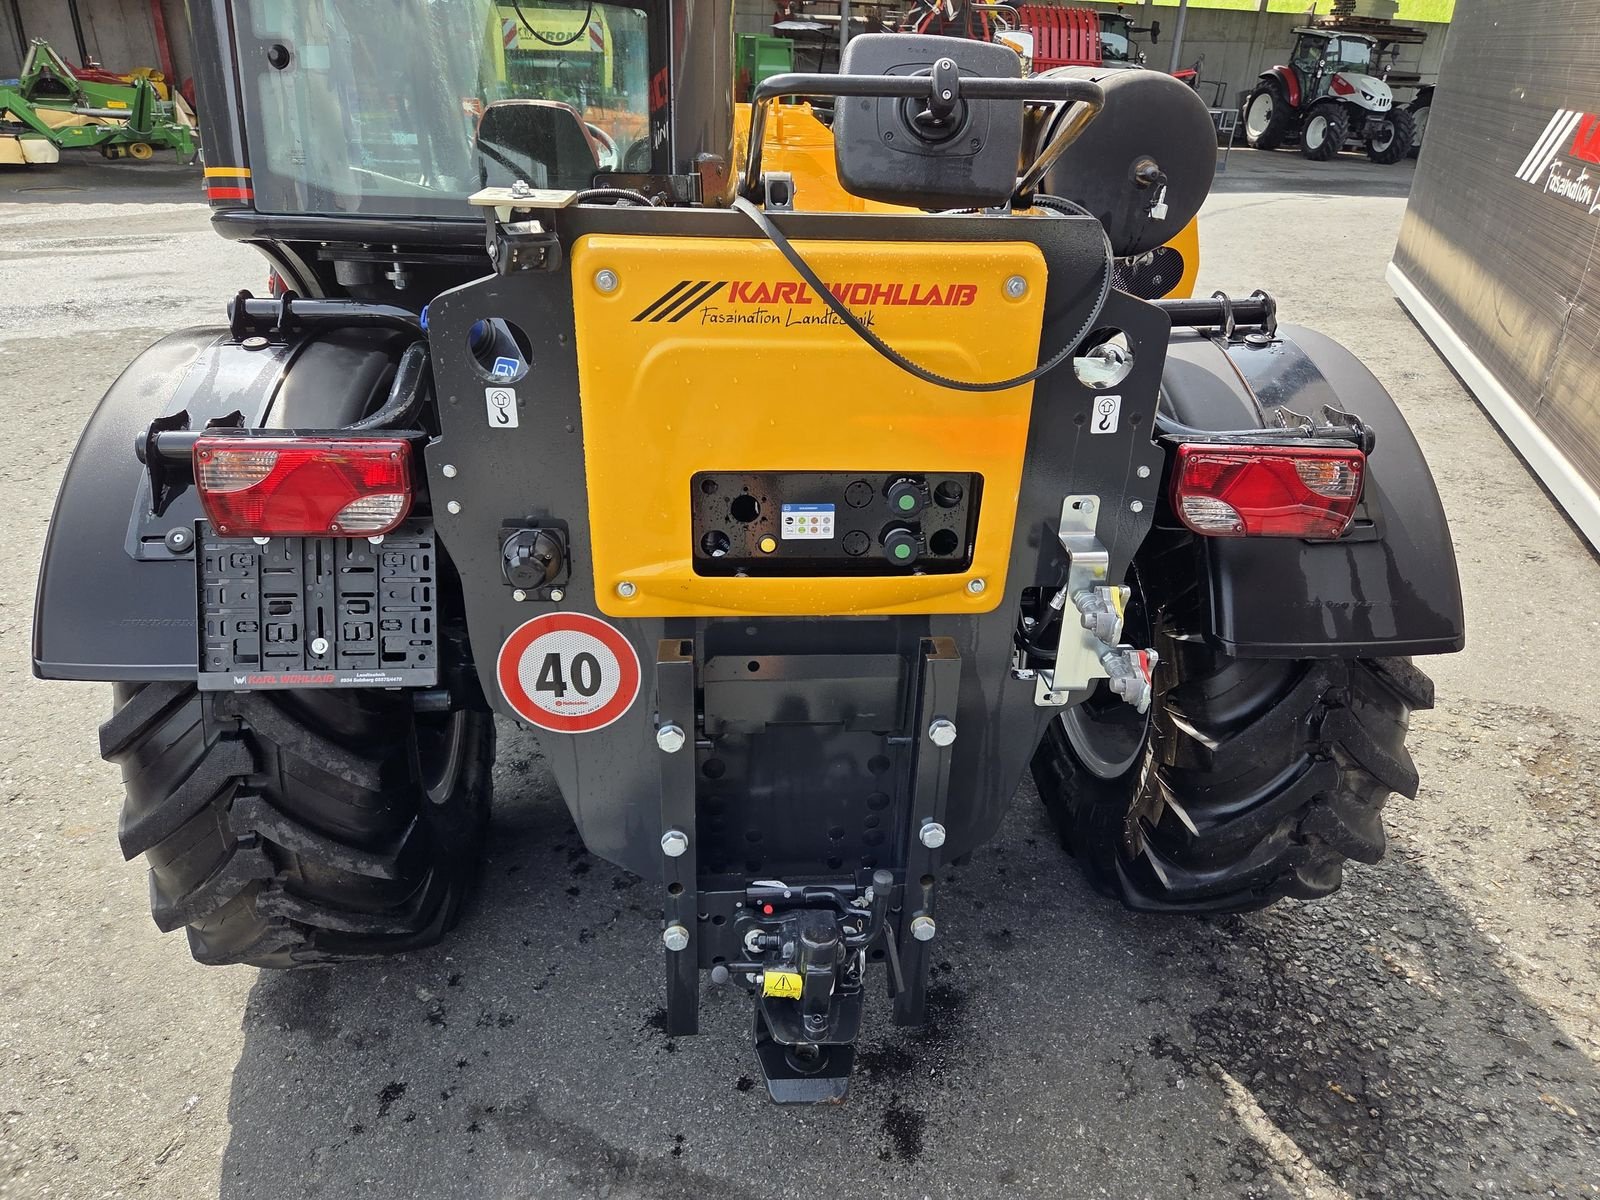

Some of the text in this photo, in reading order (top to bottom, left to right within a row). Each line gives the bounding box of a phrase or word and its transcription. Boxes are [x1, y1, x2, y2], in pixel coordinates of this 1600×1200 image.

[1543, 158, 1592, 205] Faszination
[728, 281, 979, 307] KARL WOHLLAIB
[699, 306, 781, 326] Faszination
[248, 674, 277, 684] KARL
[535, 651, 602, 698] 40
